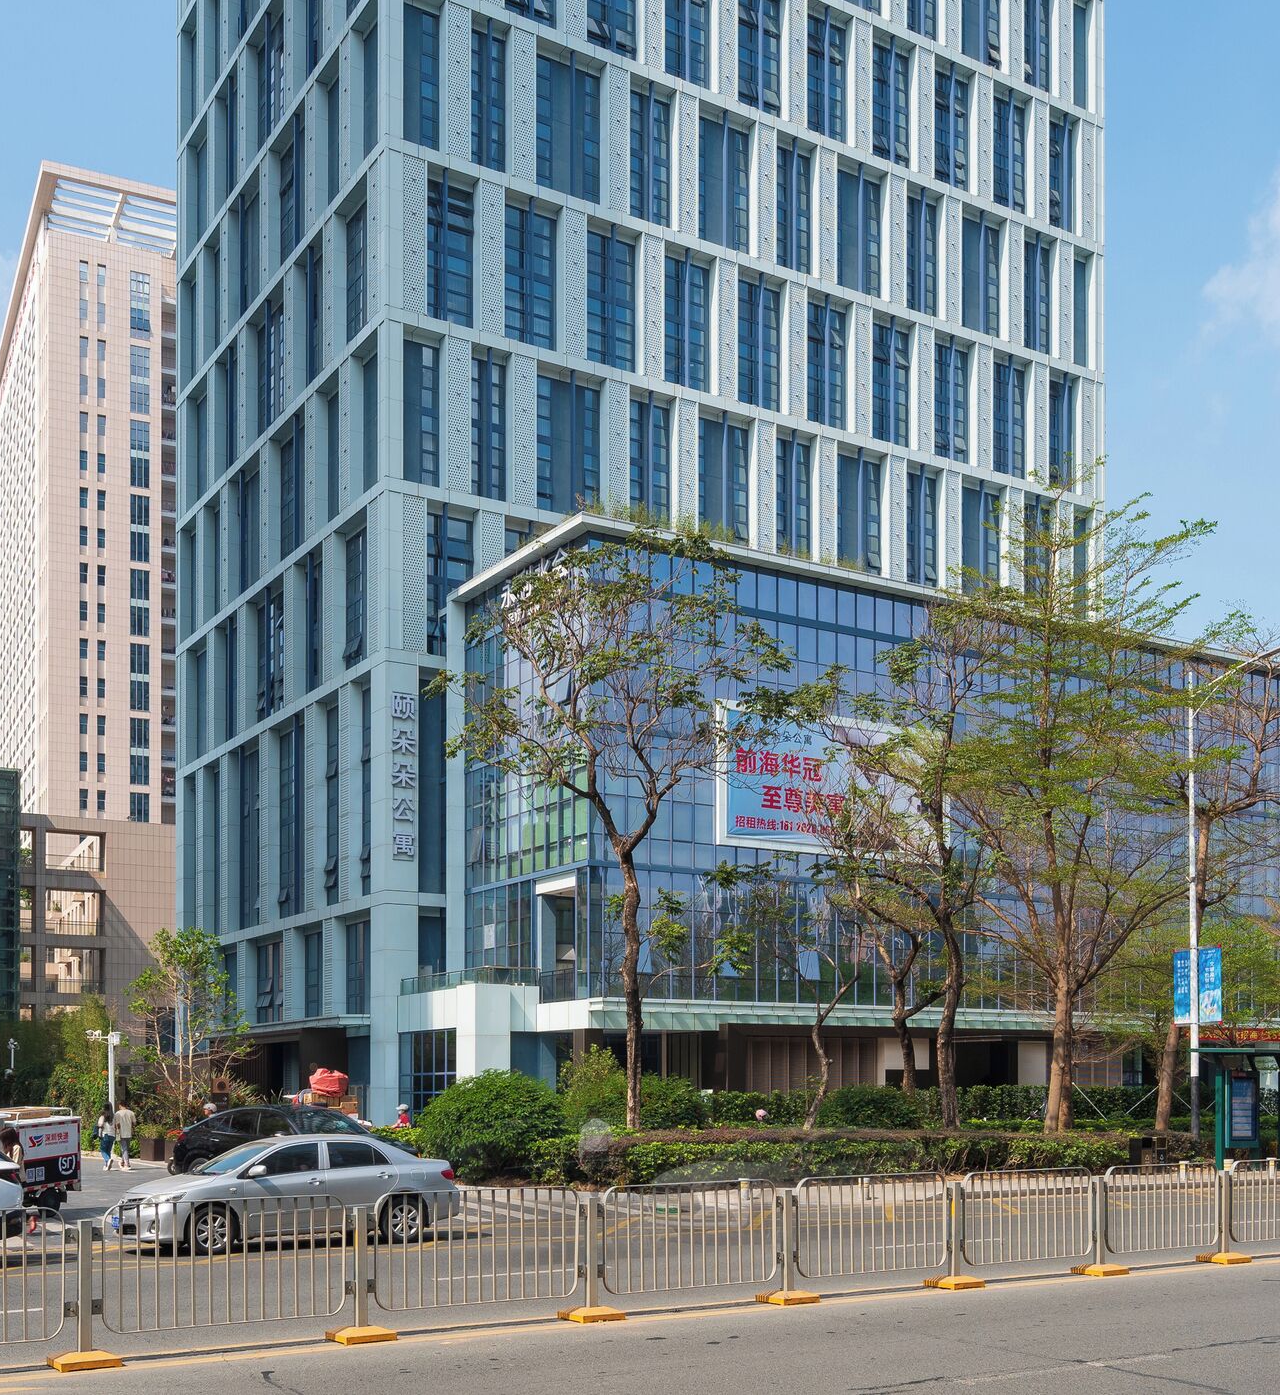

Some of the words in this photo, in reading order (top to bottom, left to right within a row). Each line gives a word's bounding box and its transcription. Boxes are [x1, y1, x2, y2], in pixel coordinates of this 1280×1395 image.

[391, 693, 416, 857] 颐朵朵公寓
[735, 747, 822, 782] 前海华冠
